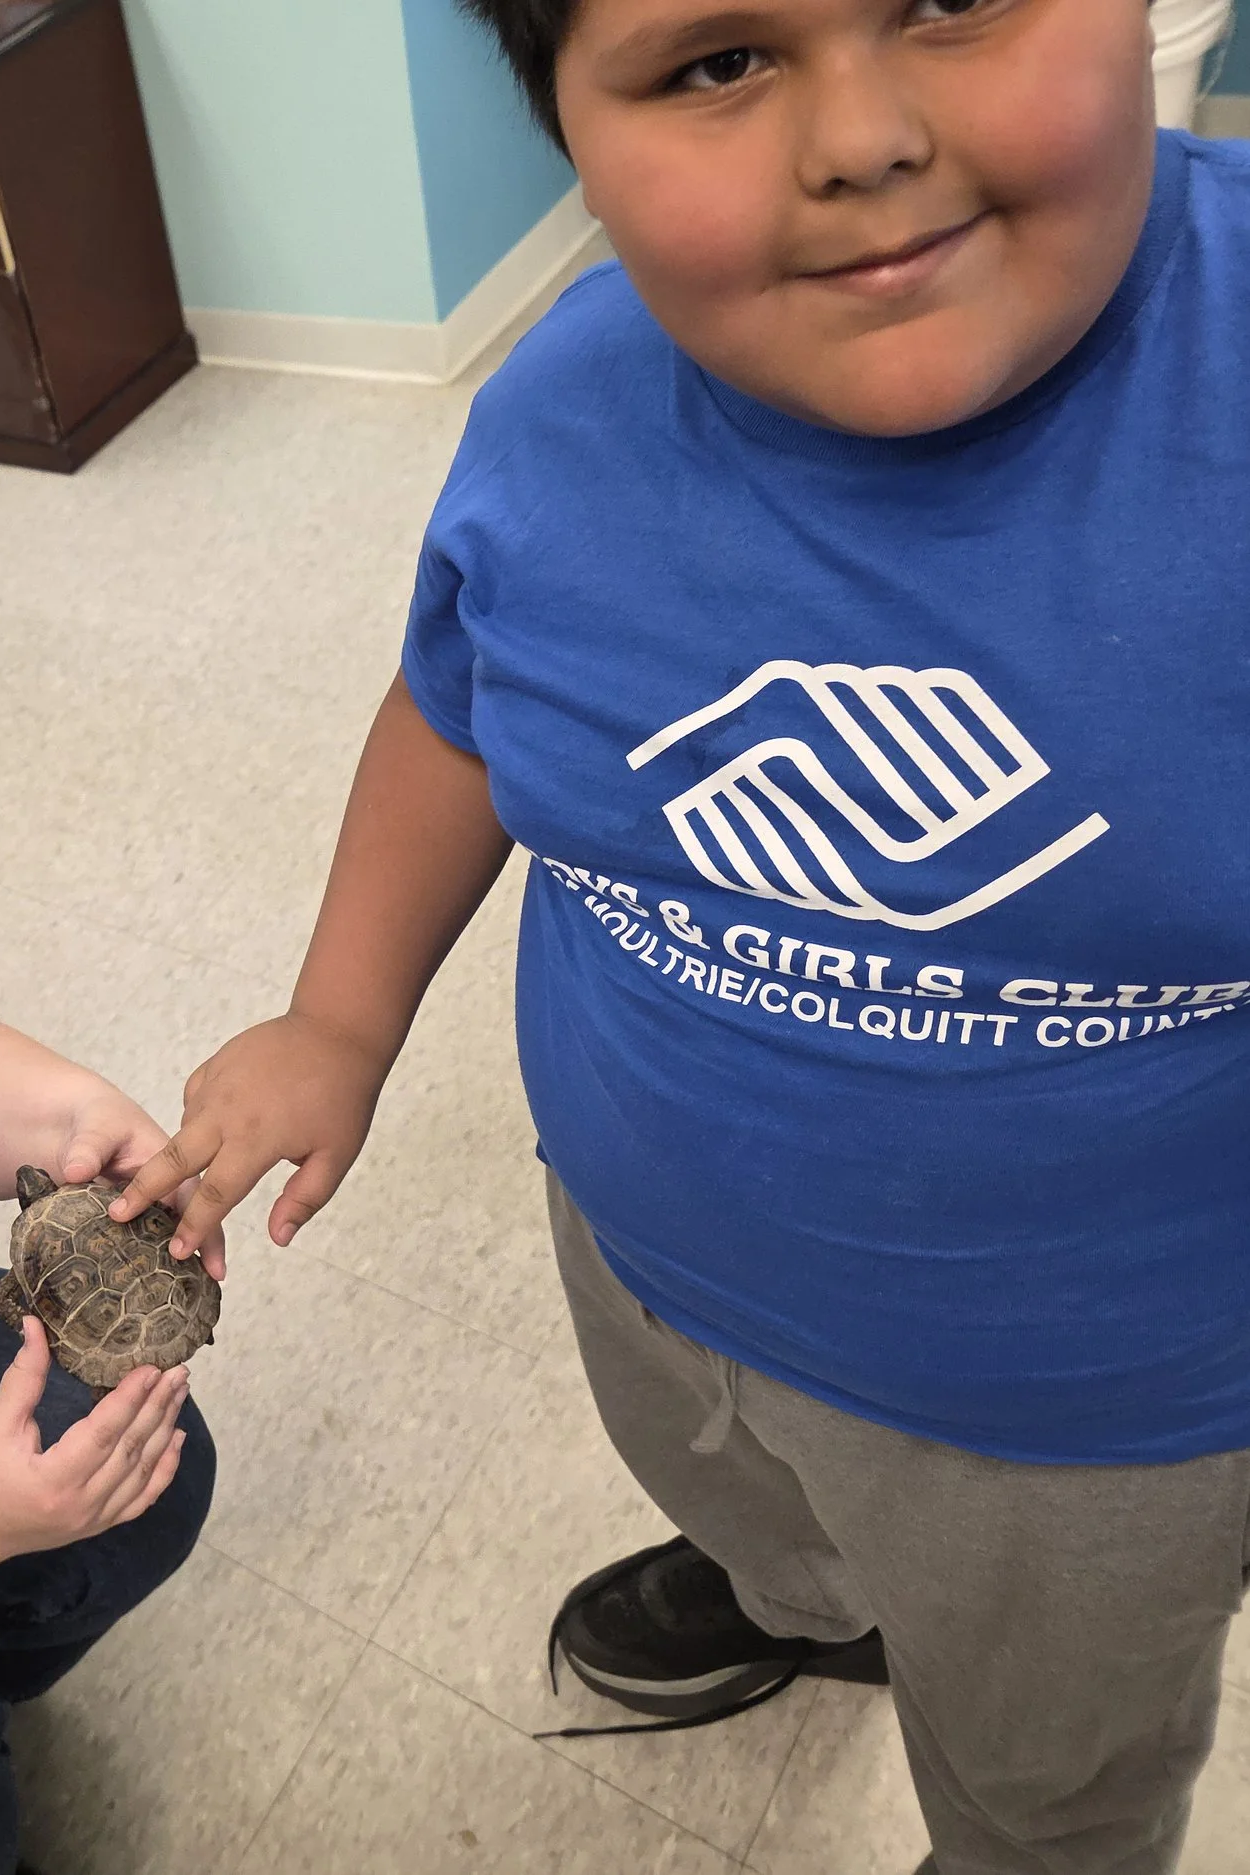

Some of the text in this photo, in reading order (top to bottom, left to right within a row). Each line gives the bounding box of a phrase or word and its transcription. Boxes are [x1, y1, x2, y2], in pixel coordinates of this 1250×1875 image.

[658, 900, 710, 950] &
[722, 924, 964, 999] GIRLS
[999, 979, 1250, 1008] CLUB
[1036, 1003, 1236, 1048] COUNT
